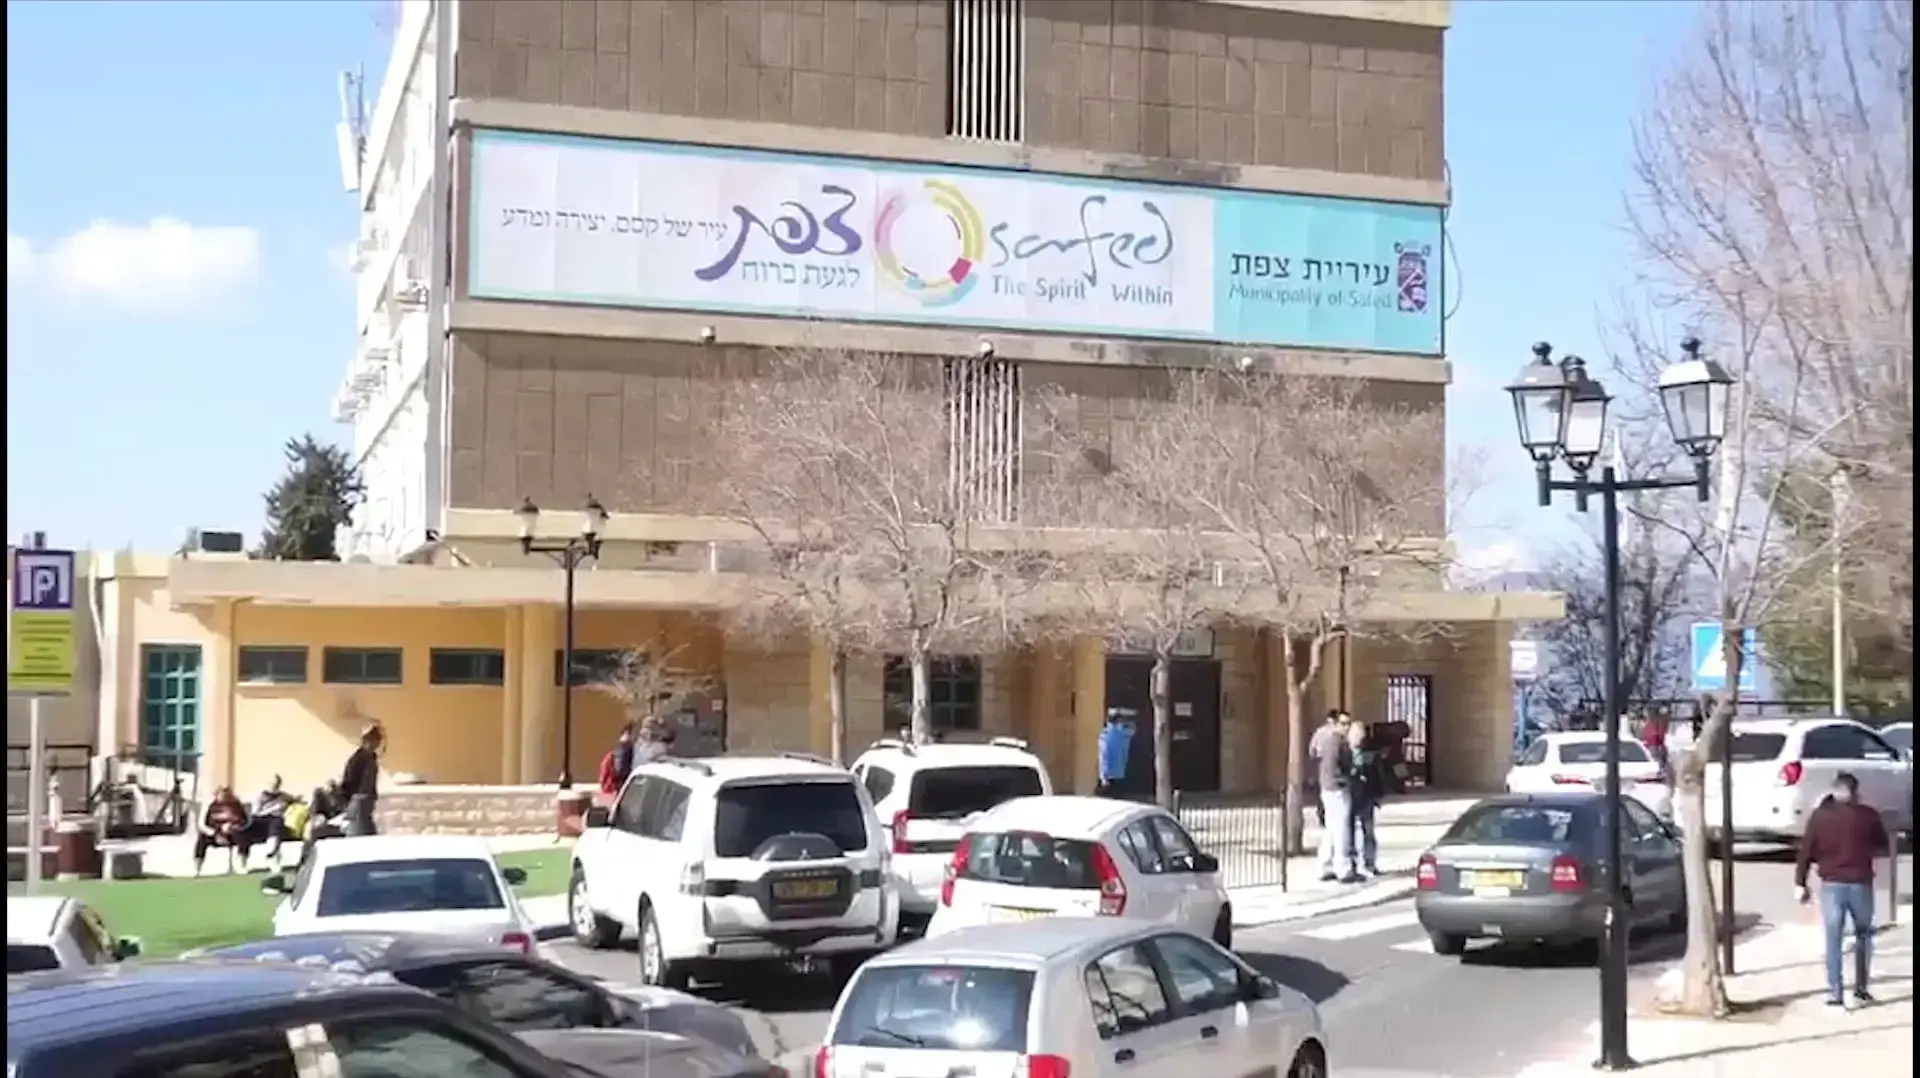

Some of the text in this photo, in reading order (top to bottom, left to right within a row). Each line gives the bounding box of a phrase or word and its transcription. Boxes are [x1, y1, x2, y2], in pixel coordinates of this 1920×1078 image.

[502, 206, 551, 228] ומדע
[555, 209, 606, 232] יצירה
[663, 212, 692, 238] של
[698, 219, 728, 241] עיר
[694, 183, 863, 282] צפת
[741, 260, 861, 288] לגעת ברוח
[1231, 252, 1390, 287] עיריית צפת
[992, 274, 1174, 306] The Spirit Within
[1228, 282, 1392, 309] Municipality of Safed
